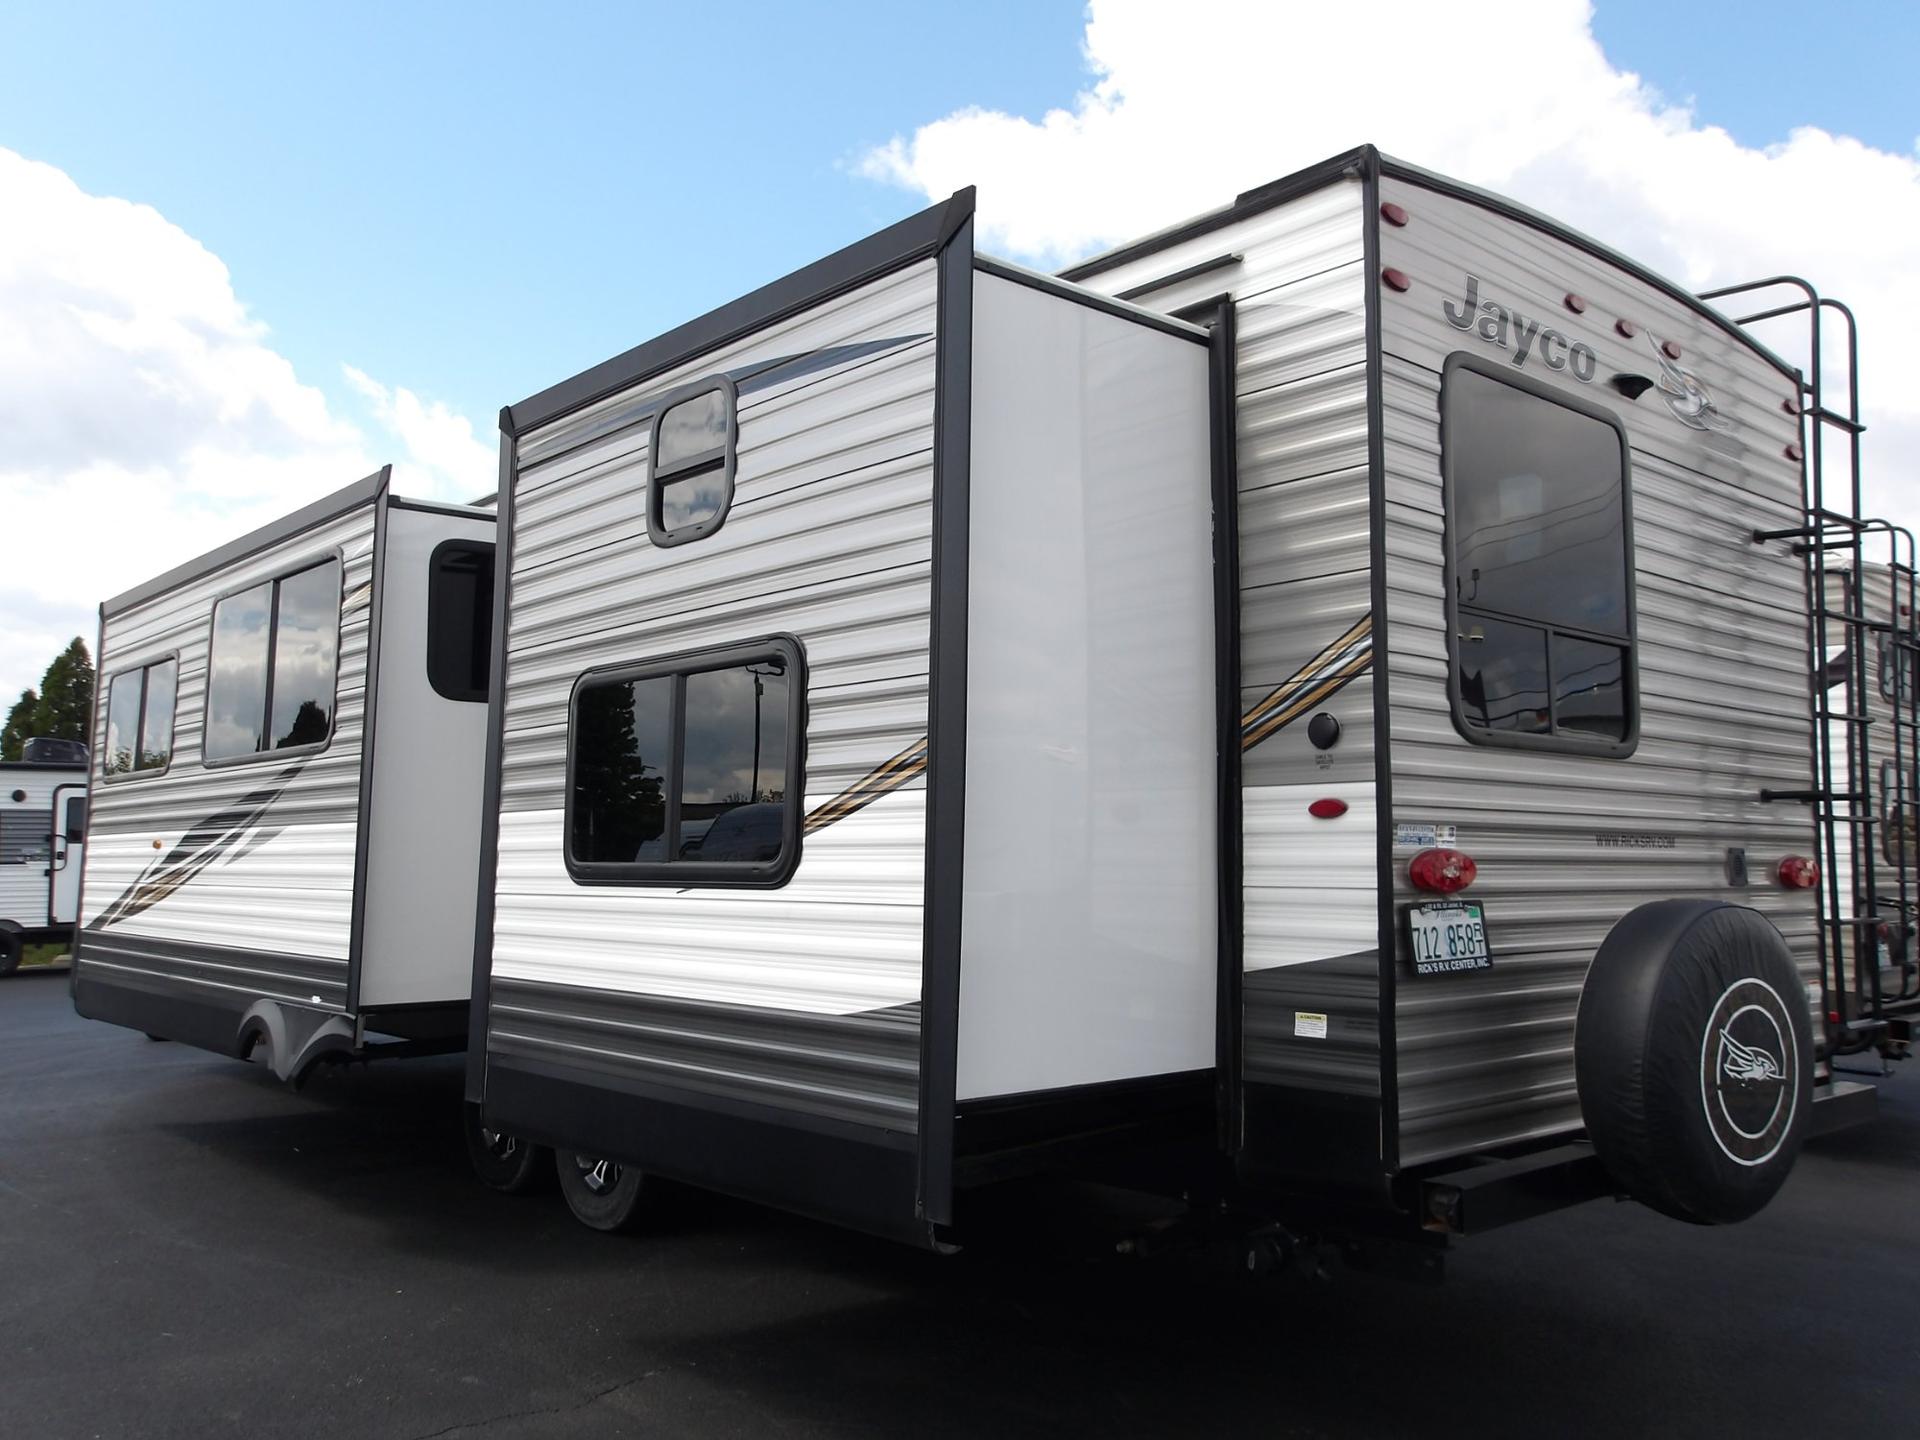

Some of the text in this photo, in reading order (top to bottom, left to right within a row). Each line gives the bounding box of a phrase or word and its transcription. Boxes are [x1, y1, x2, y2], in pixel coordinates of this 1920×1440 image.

[1443, 272, 1597, 384] Jayco
[1412, 923, 1475, 960] 712 858
